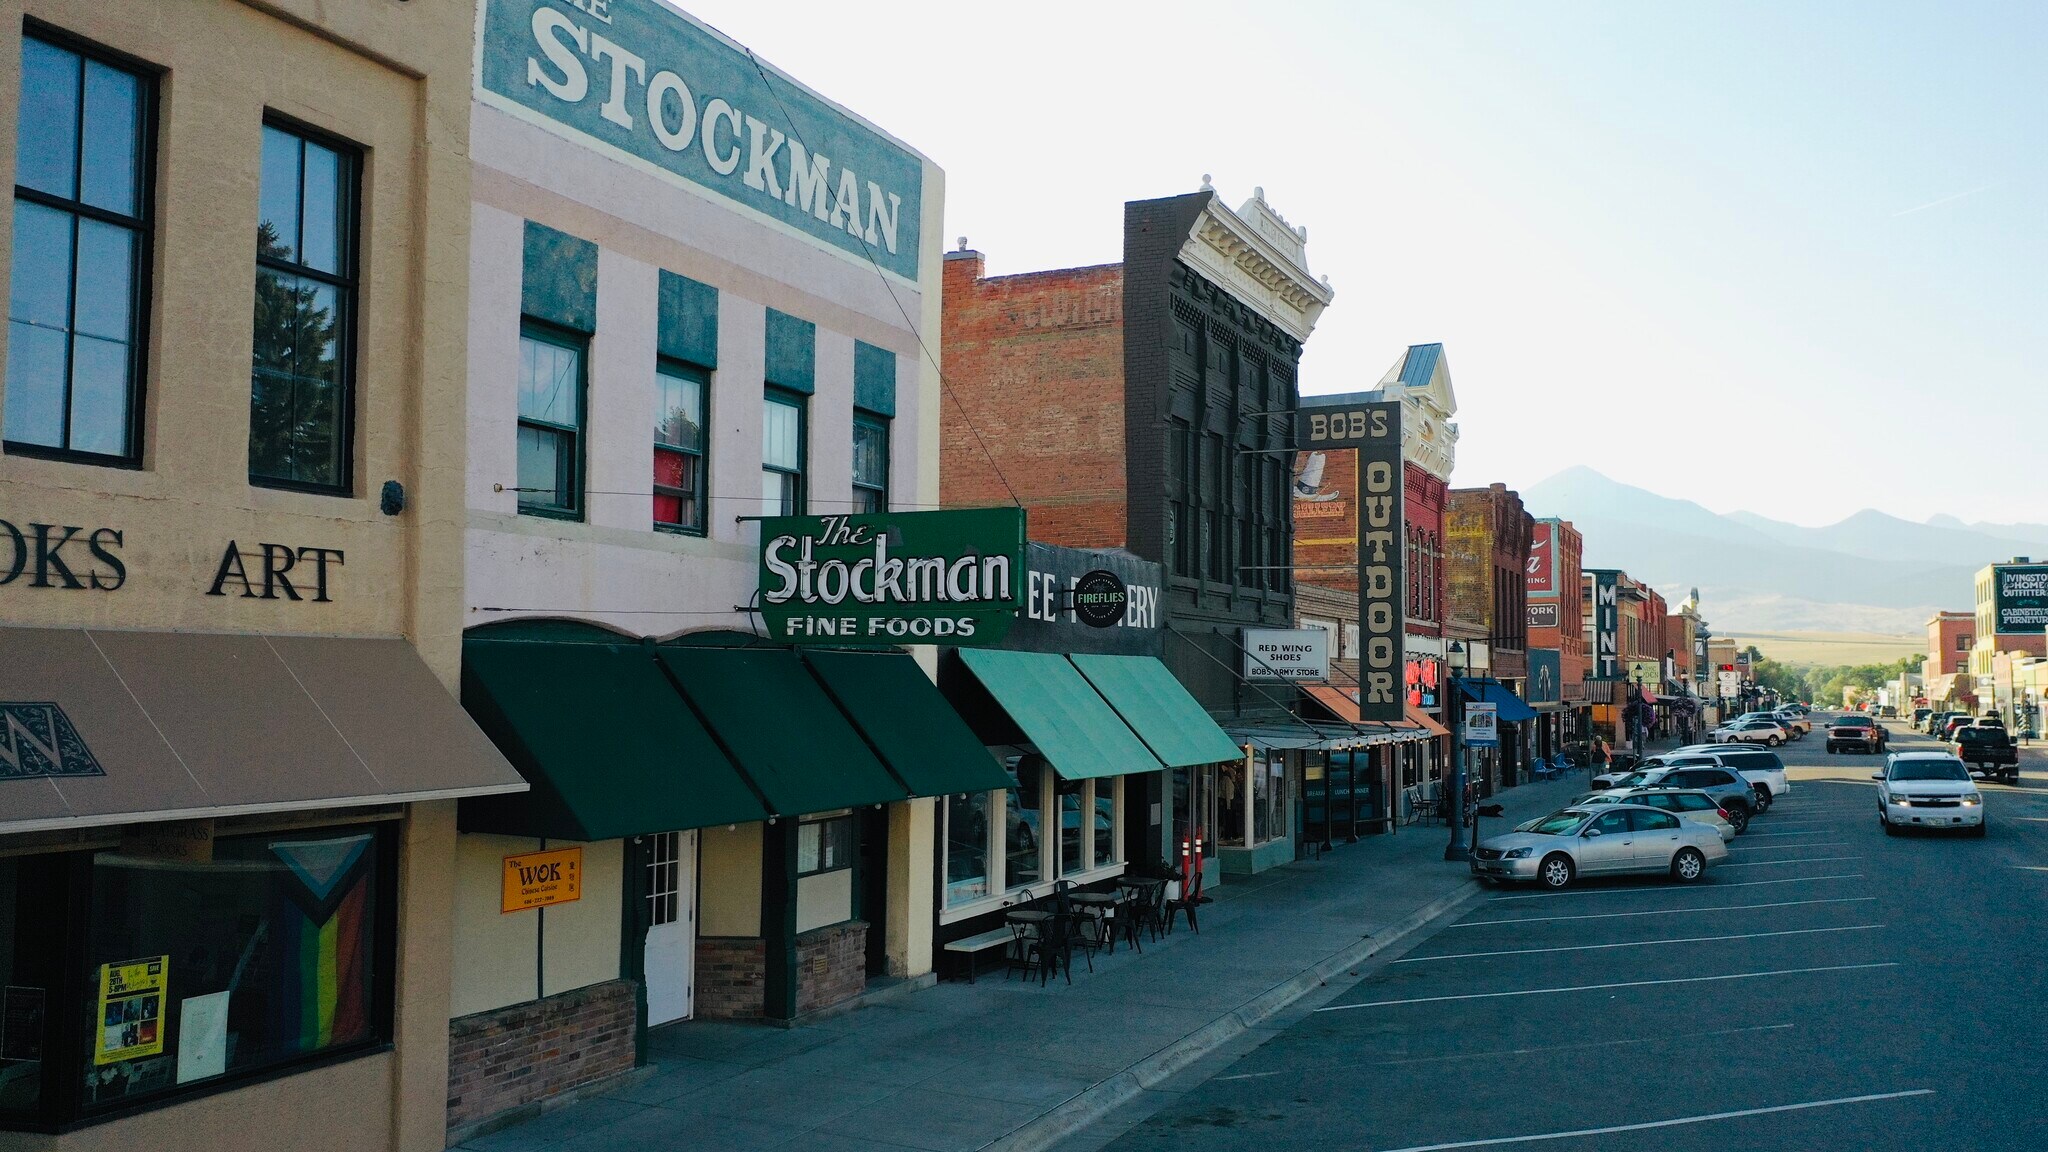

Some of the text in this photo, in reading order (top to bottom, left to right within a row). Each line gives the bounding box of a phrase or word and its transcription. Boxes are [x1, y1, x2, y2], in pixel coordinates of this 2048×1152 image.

[527, 6, 901, 254] STOCKMAN
[1310, 408, 1388, 441] BOB'S
[815, 516, 875, 546] The
[206, 539, 345, 602] ART
[764, 534, 1012, 605] Stockman
[1365, 461, 1394, 704] OUTDOOR
[1077, 592, 1125, 604] FIREFLIES
[2001, 608, 2043, 616] CABINETRY
[787, 615, 976, 637] FINE FOODS
[1599, 585, 1617, 677] MINT
[1258, 644, 1278, 652] RED
[1270, 653, 1301, 661] SHOES
[1273, 668, 1294, 676] ARMY
[509, 860, 522, 868] The
[519, 862, 562, 886] WOK
[521, 883, 558, 896] Chinese Cuisine
